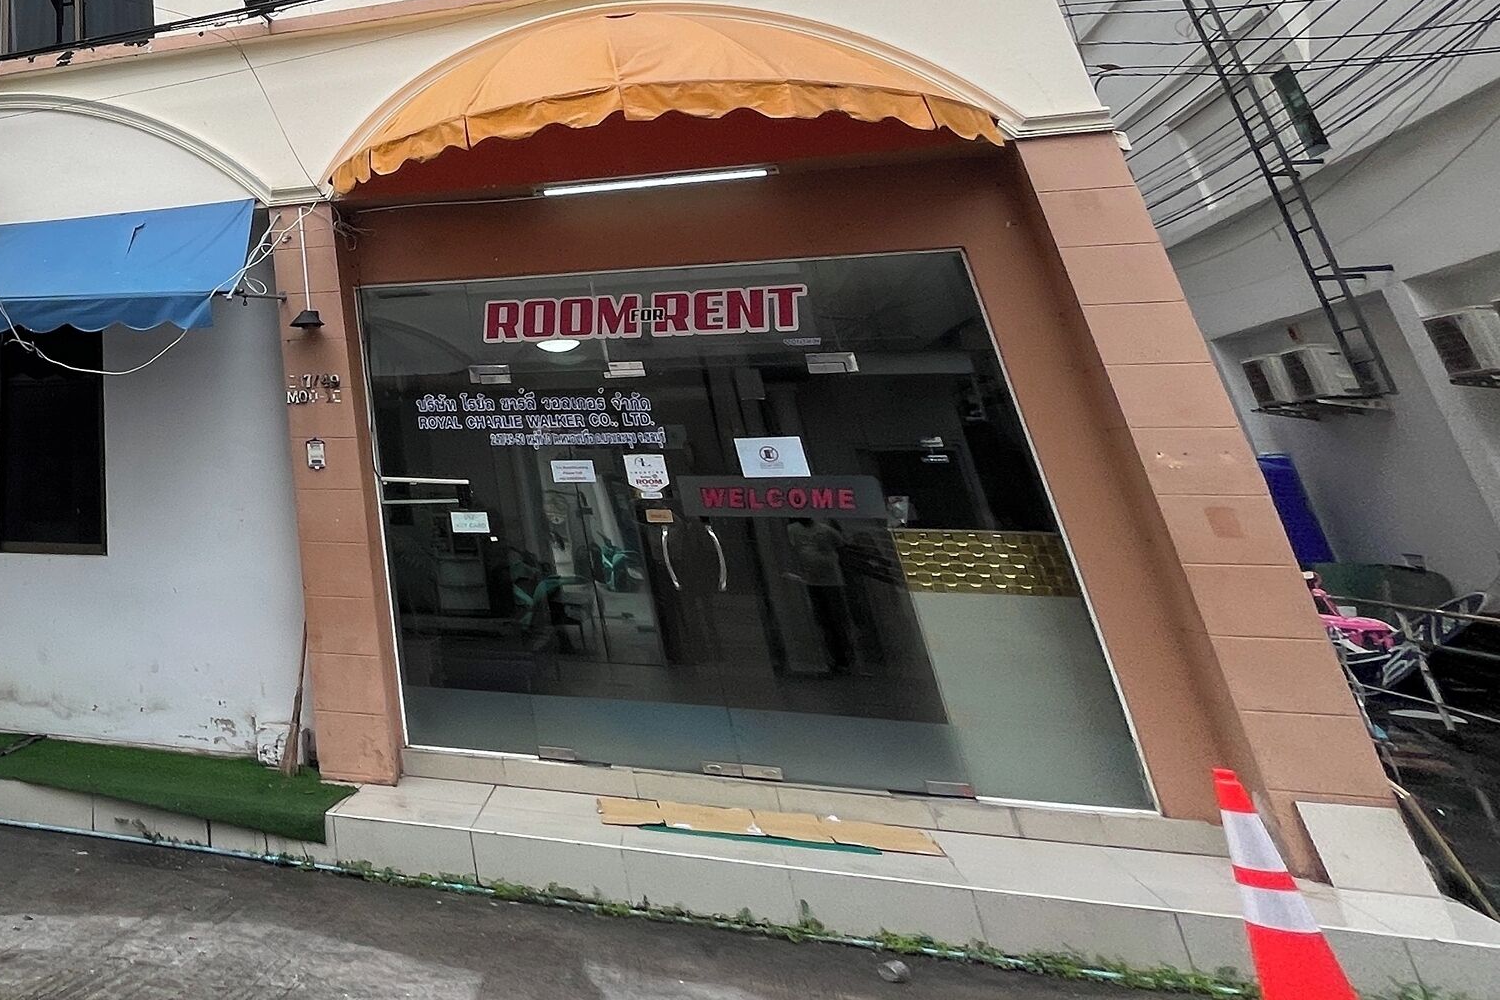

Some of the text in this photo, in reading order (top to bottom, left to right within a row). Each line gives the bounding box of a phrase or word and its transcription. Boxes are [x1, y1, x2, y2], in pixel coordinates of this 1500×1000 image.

[484, 283, 807, 343] ROOM FOR RENT
[418, 416, 463, 429] ROYAL
[465, 415, 524, 429] CHARLIE
[526, 414, 586, 428] WALKER
[621, 412, 655, 426] LTD.
[700, 487, 857, 510] WELCOME
